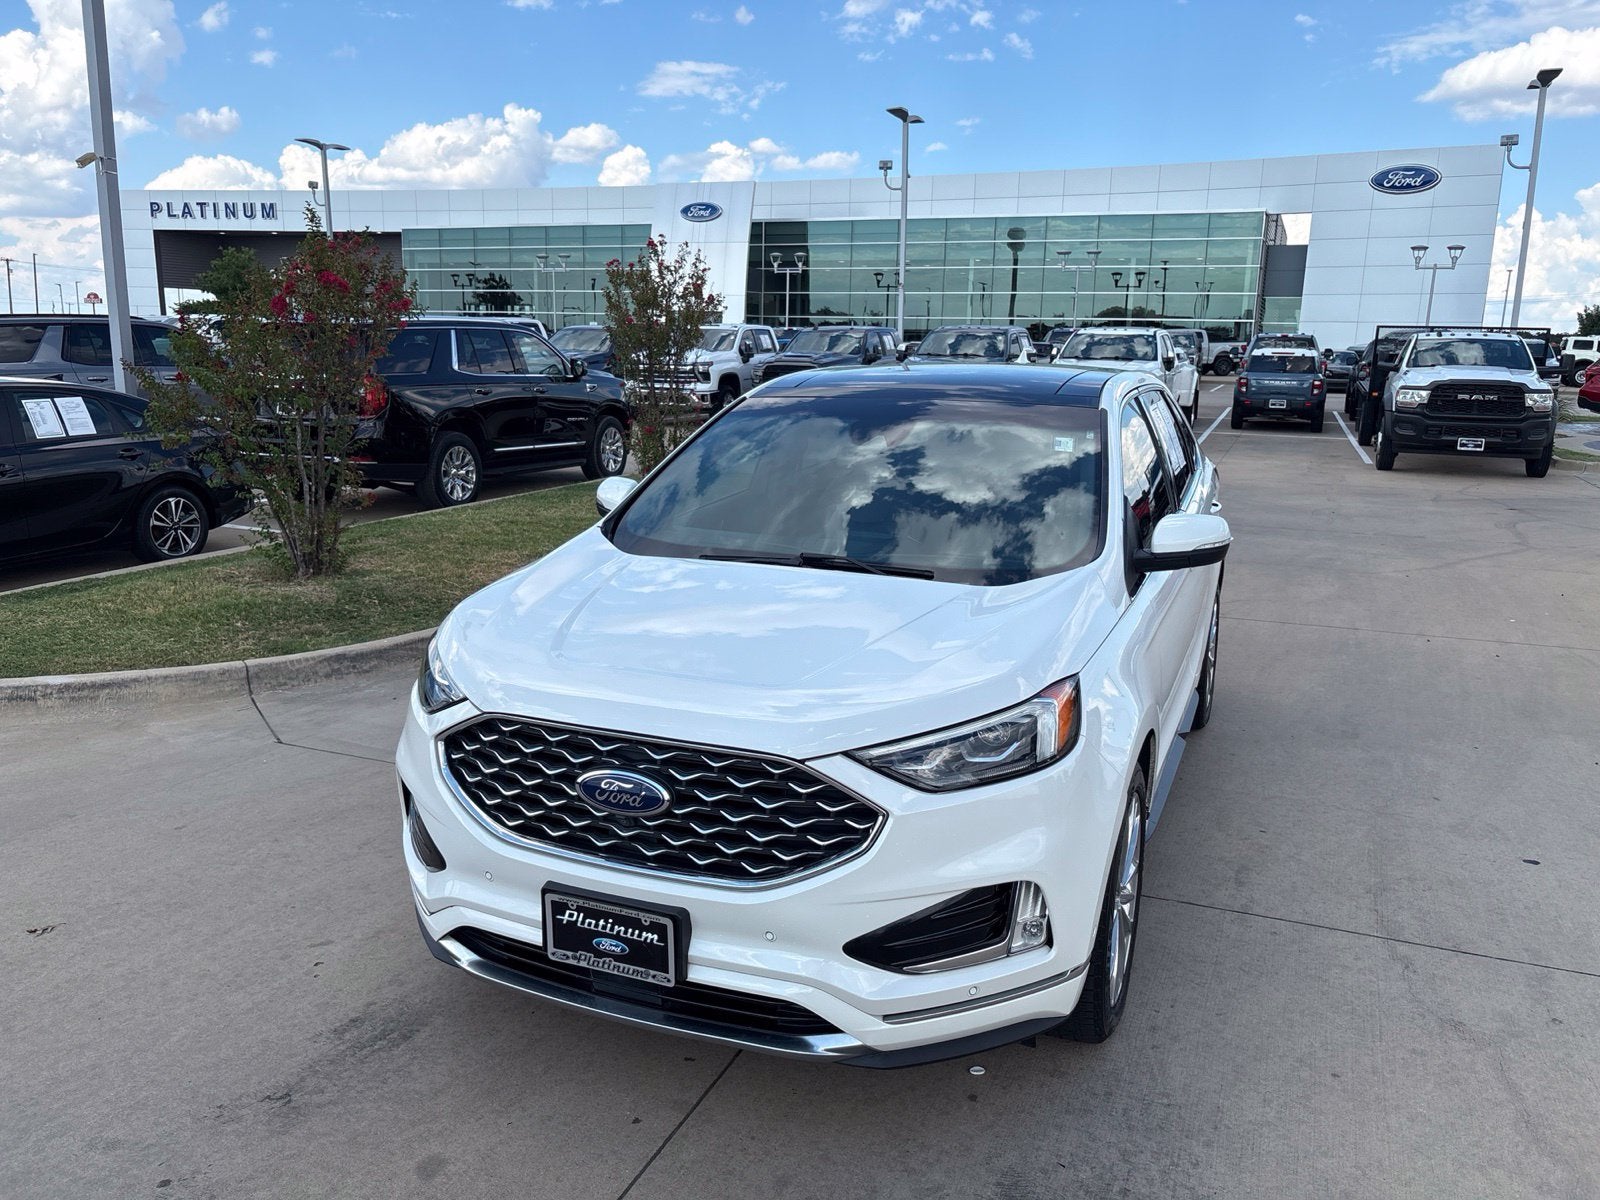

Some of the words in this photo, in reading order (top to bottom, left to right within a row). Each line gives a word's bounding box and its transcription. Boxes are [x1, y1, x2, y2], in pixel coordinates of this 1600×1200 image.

[1383, 171, 1425, 187] Ford
[149, 201, 278, 220] PLATINUM
[687, 205, 711, 217] Ford
[595, 778, 647, 807] Ford
[556, 909, 665, 946] Platinum
[599, 940, 622, 953] Ford
[577, 952, 645, 980] Platinum
